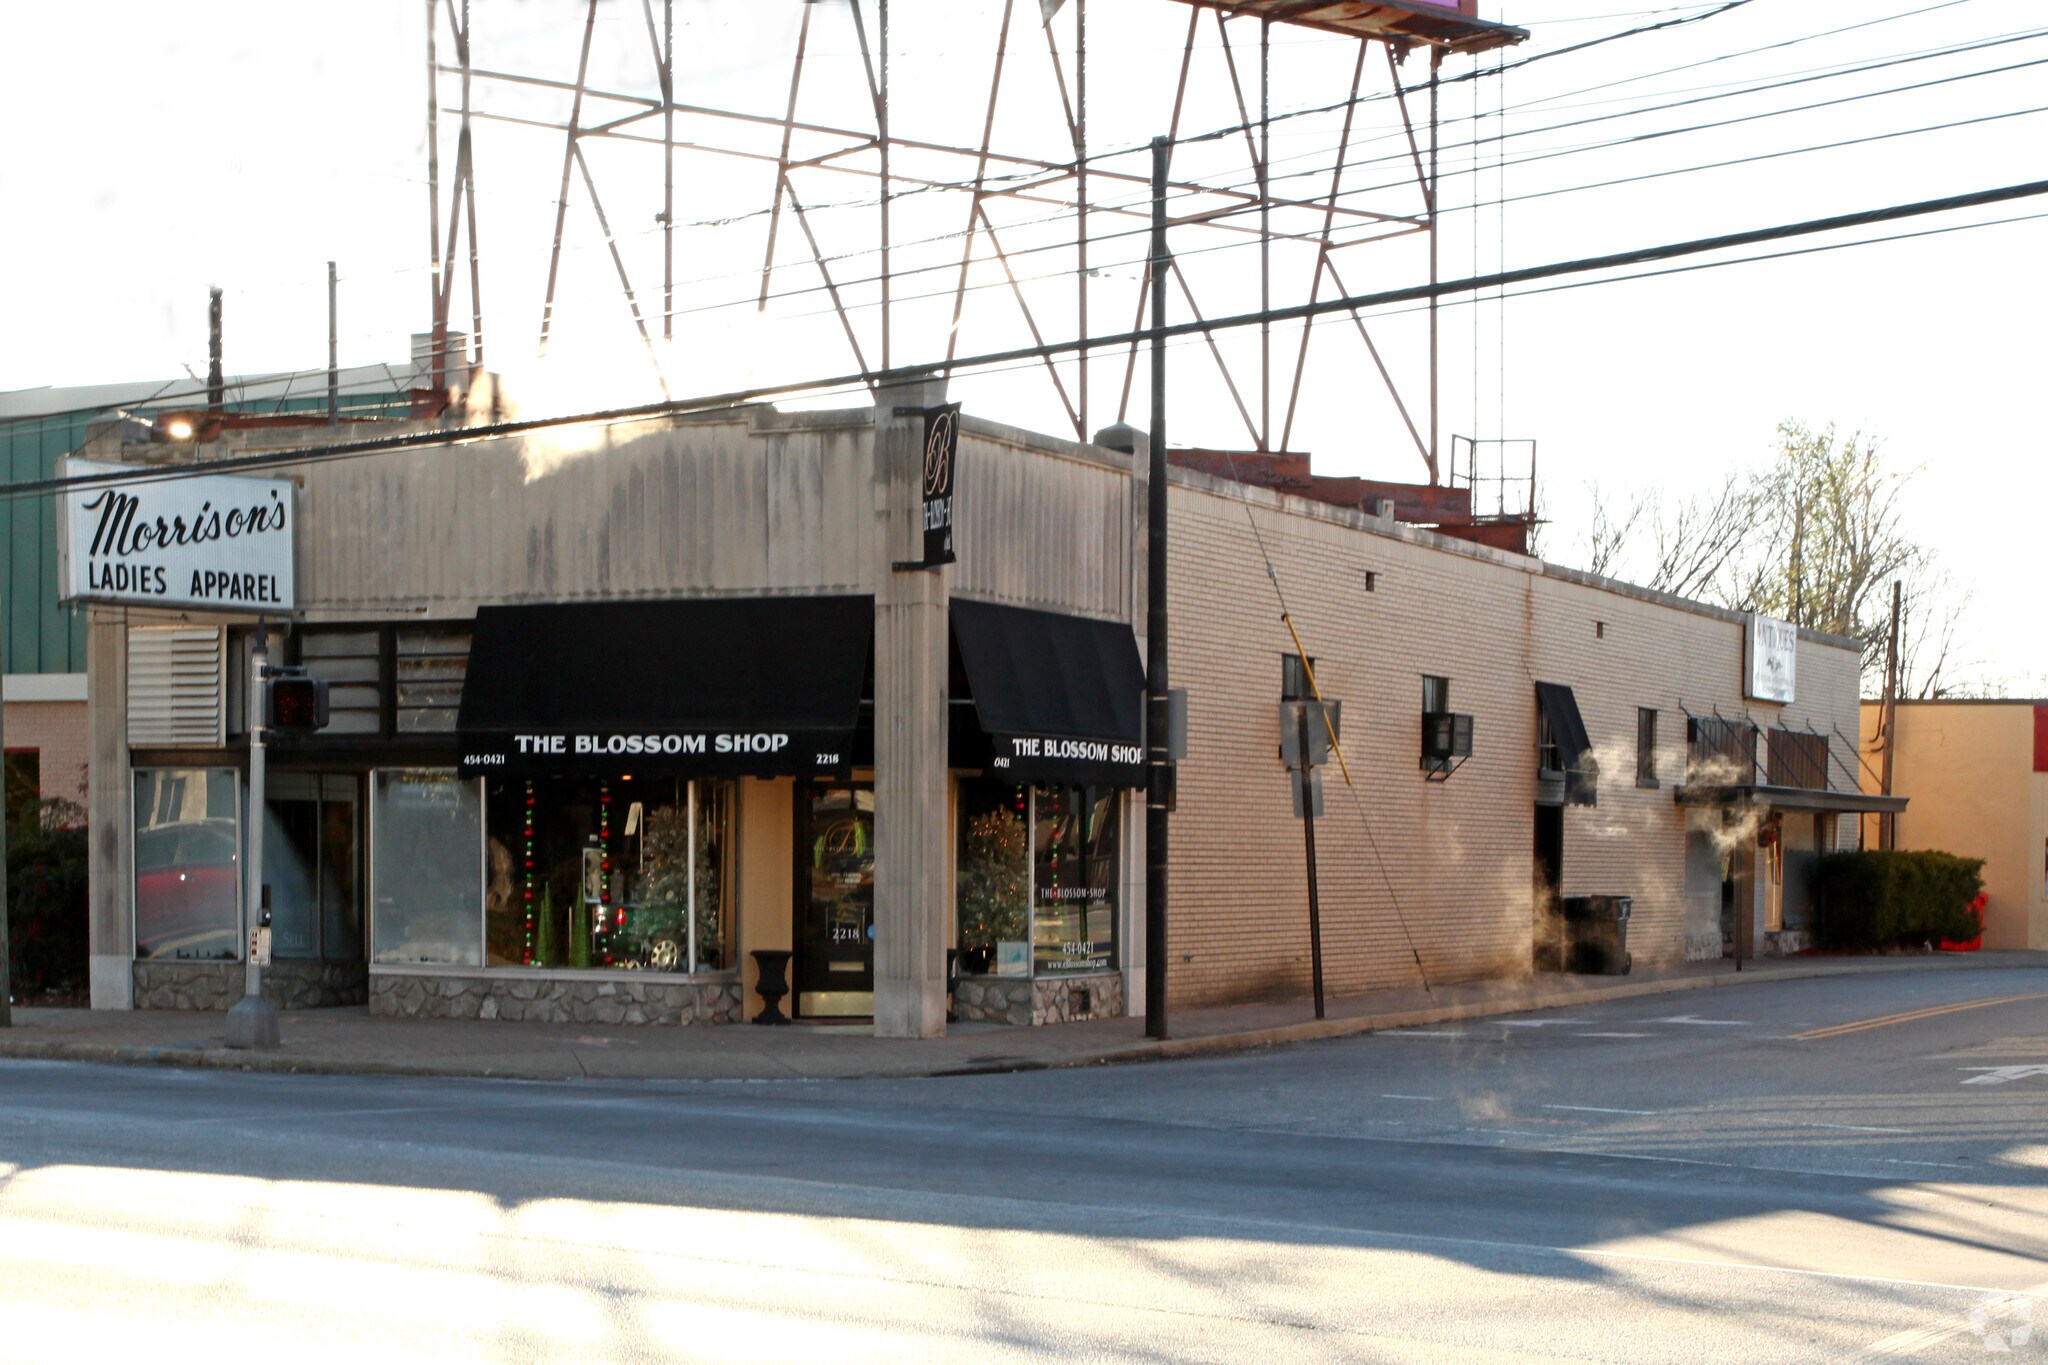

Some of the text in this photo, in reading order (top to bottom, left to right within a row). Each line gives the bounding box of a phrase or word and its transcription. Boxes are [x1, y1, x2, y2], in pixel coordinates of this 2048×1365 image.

[82, 489, 286, 558] Morrison's
[89, 561, 282, 603] LADIES APPAREL
[514, 733, 789, 755] THE BLOSSOM SHOP
[1012, 738, 1143, 765] THE BLOSSOM SHOP
[463, 754, 505, 766] 454-0421
[816, 753, 839, 765] 2218
[832, 928, 860, 940] 2218
[1062, 941, 1094, 955] 454-0421
